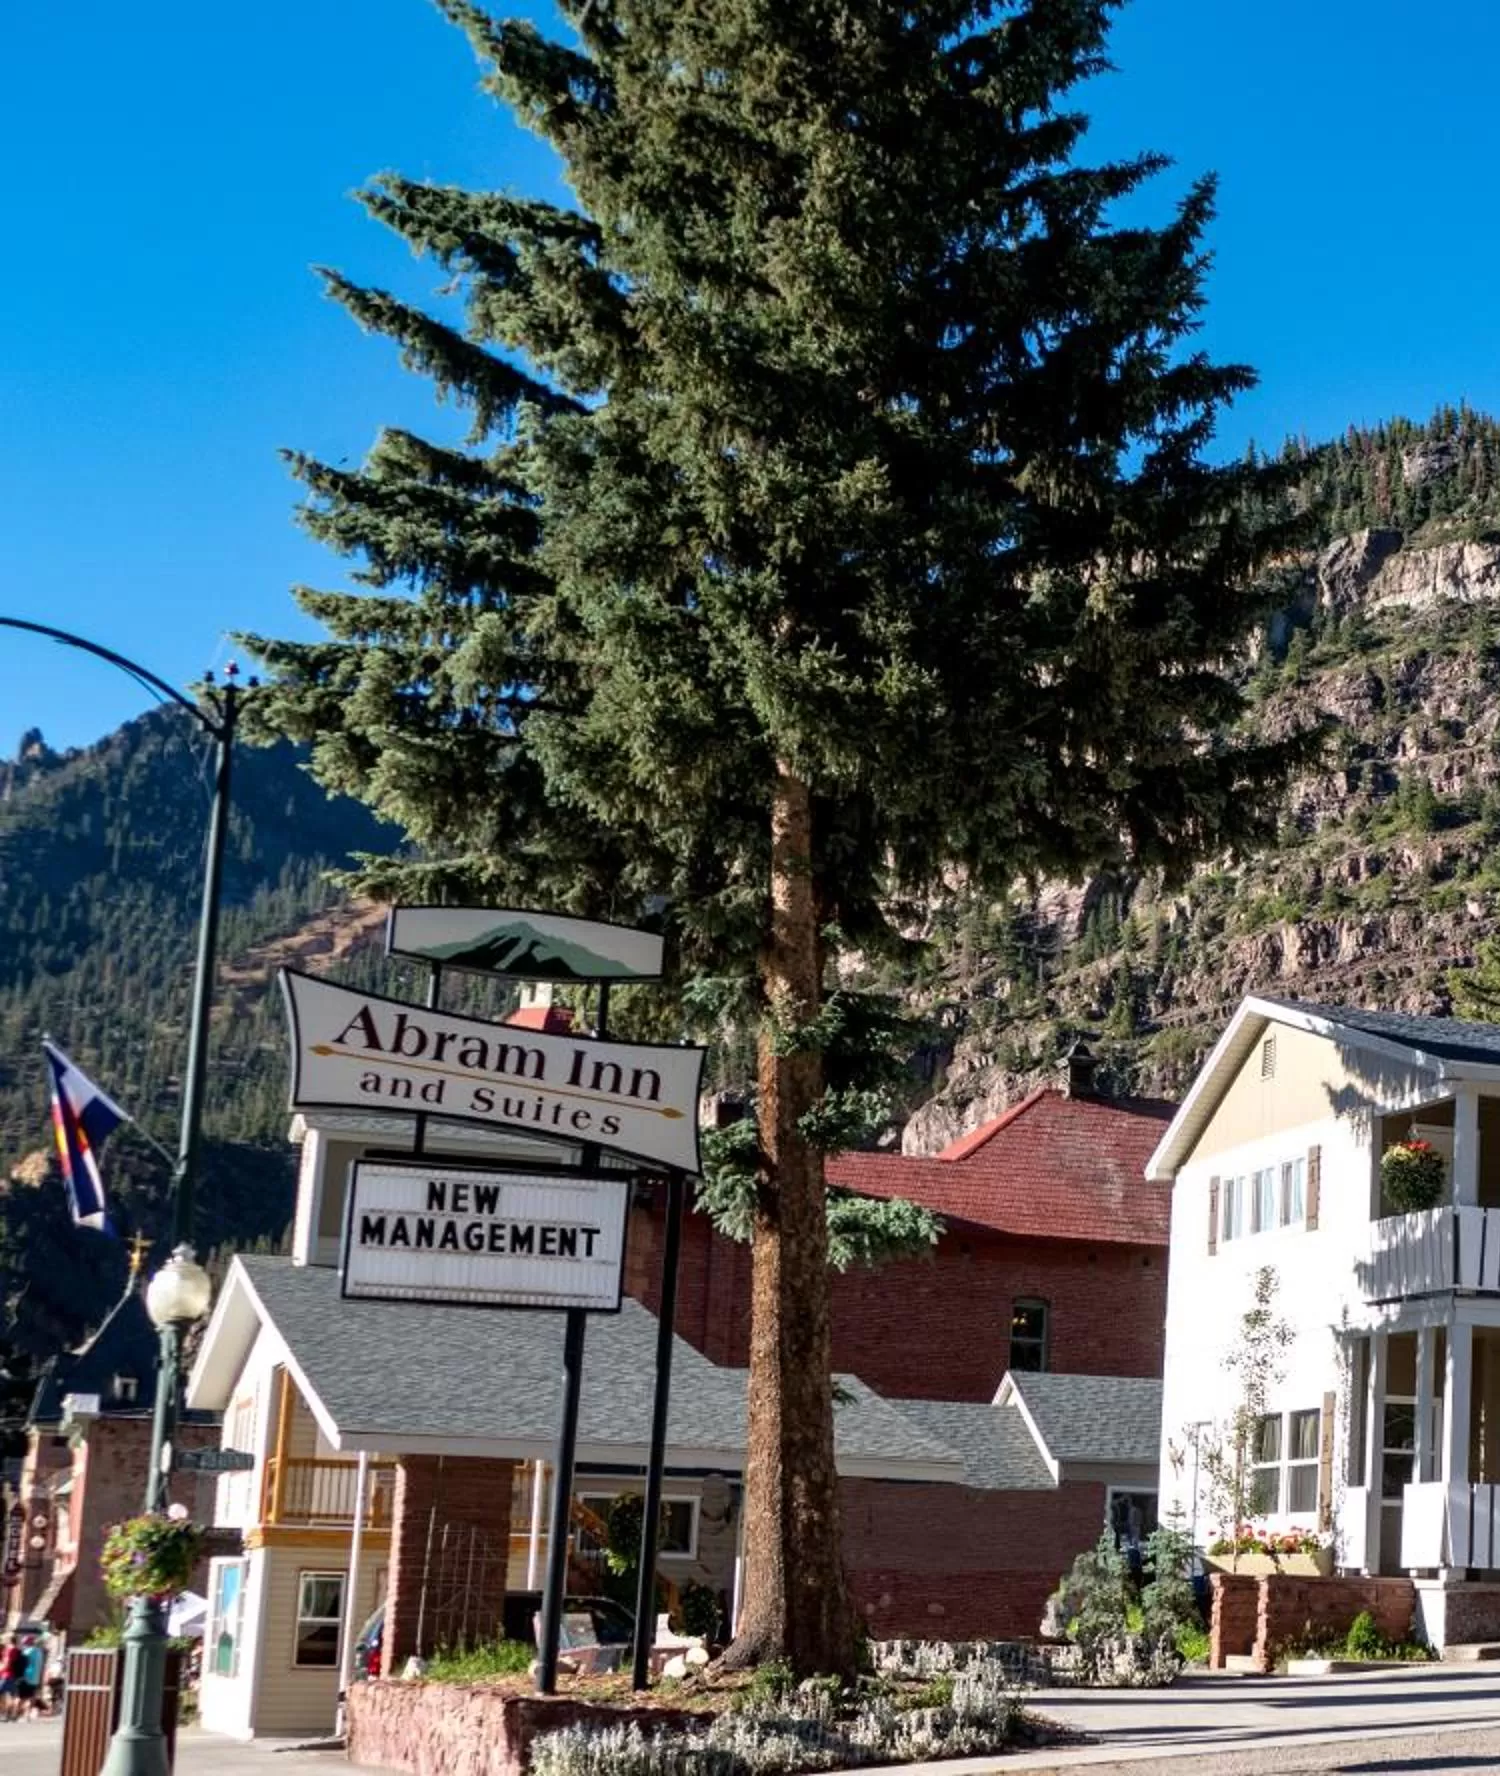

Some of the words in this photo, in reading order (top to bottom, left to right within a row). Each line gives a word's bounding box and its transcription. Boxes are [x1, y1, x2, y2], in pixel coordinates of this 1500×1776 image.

[332, 1003, 546, 1081] Abram
[566, 1048, 663, 1102] Inn
[358, 1069, 446, 1105] and
[469, 1086, 622, 1136] Suites
[426, 1180, 500, 1215] NEW
[359, 1215, 601, 1258] MANAGEMENT
